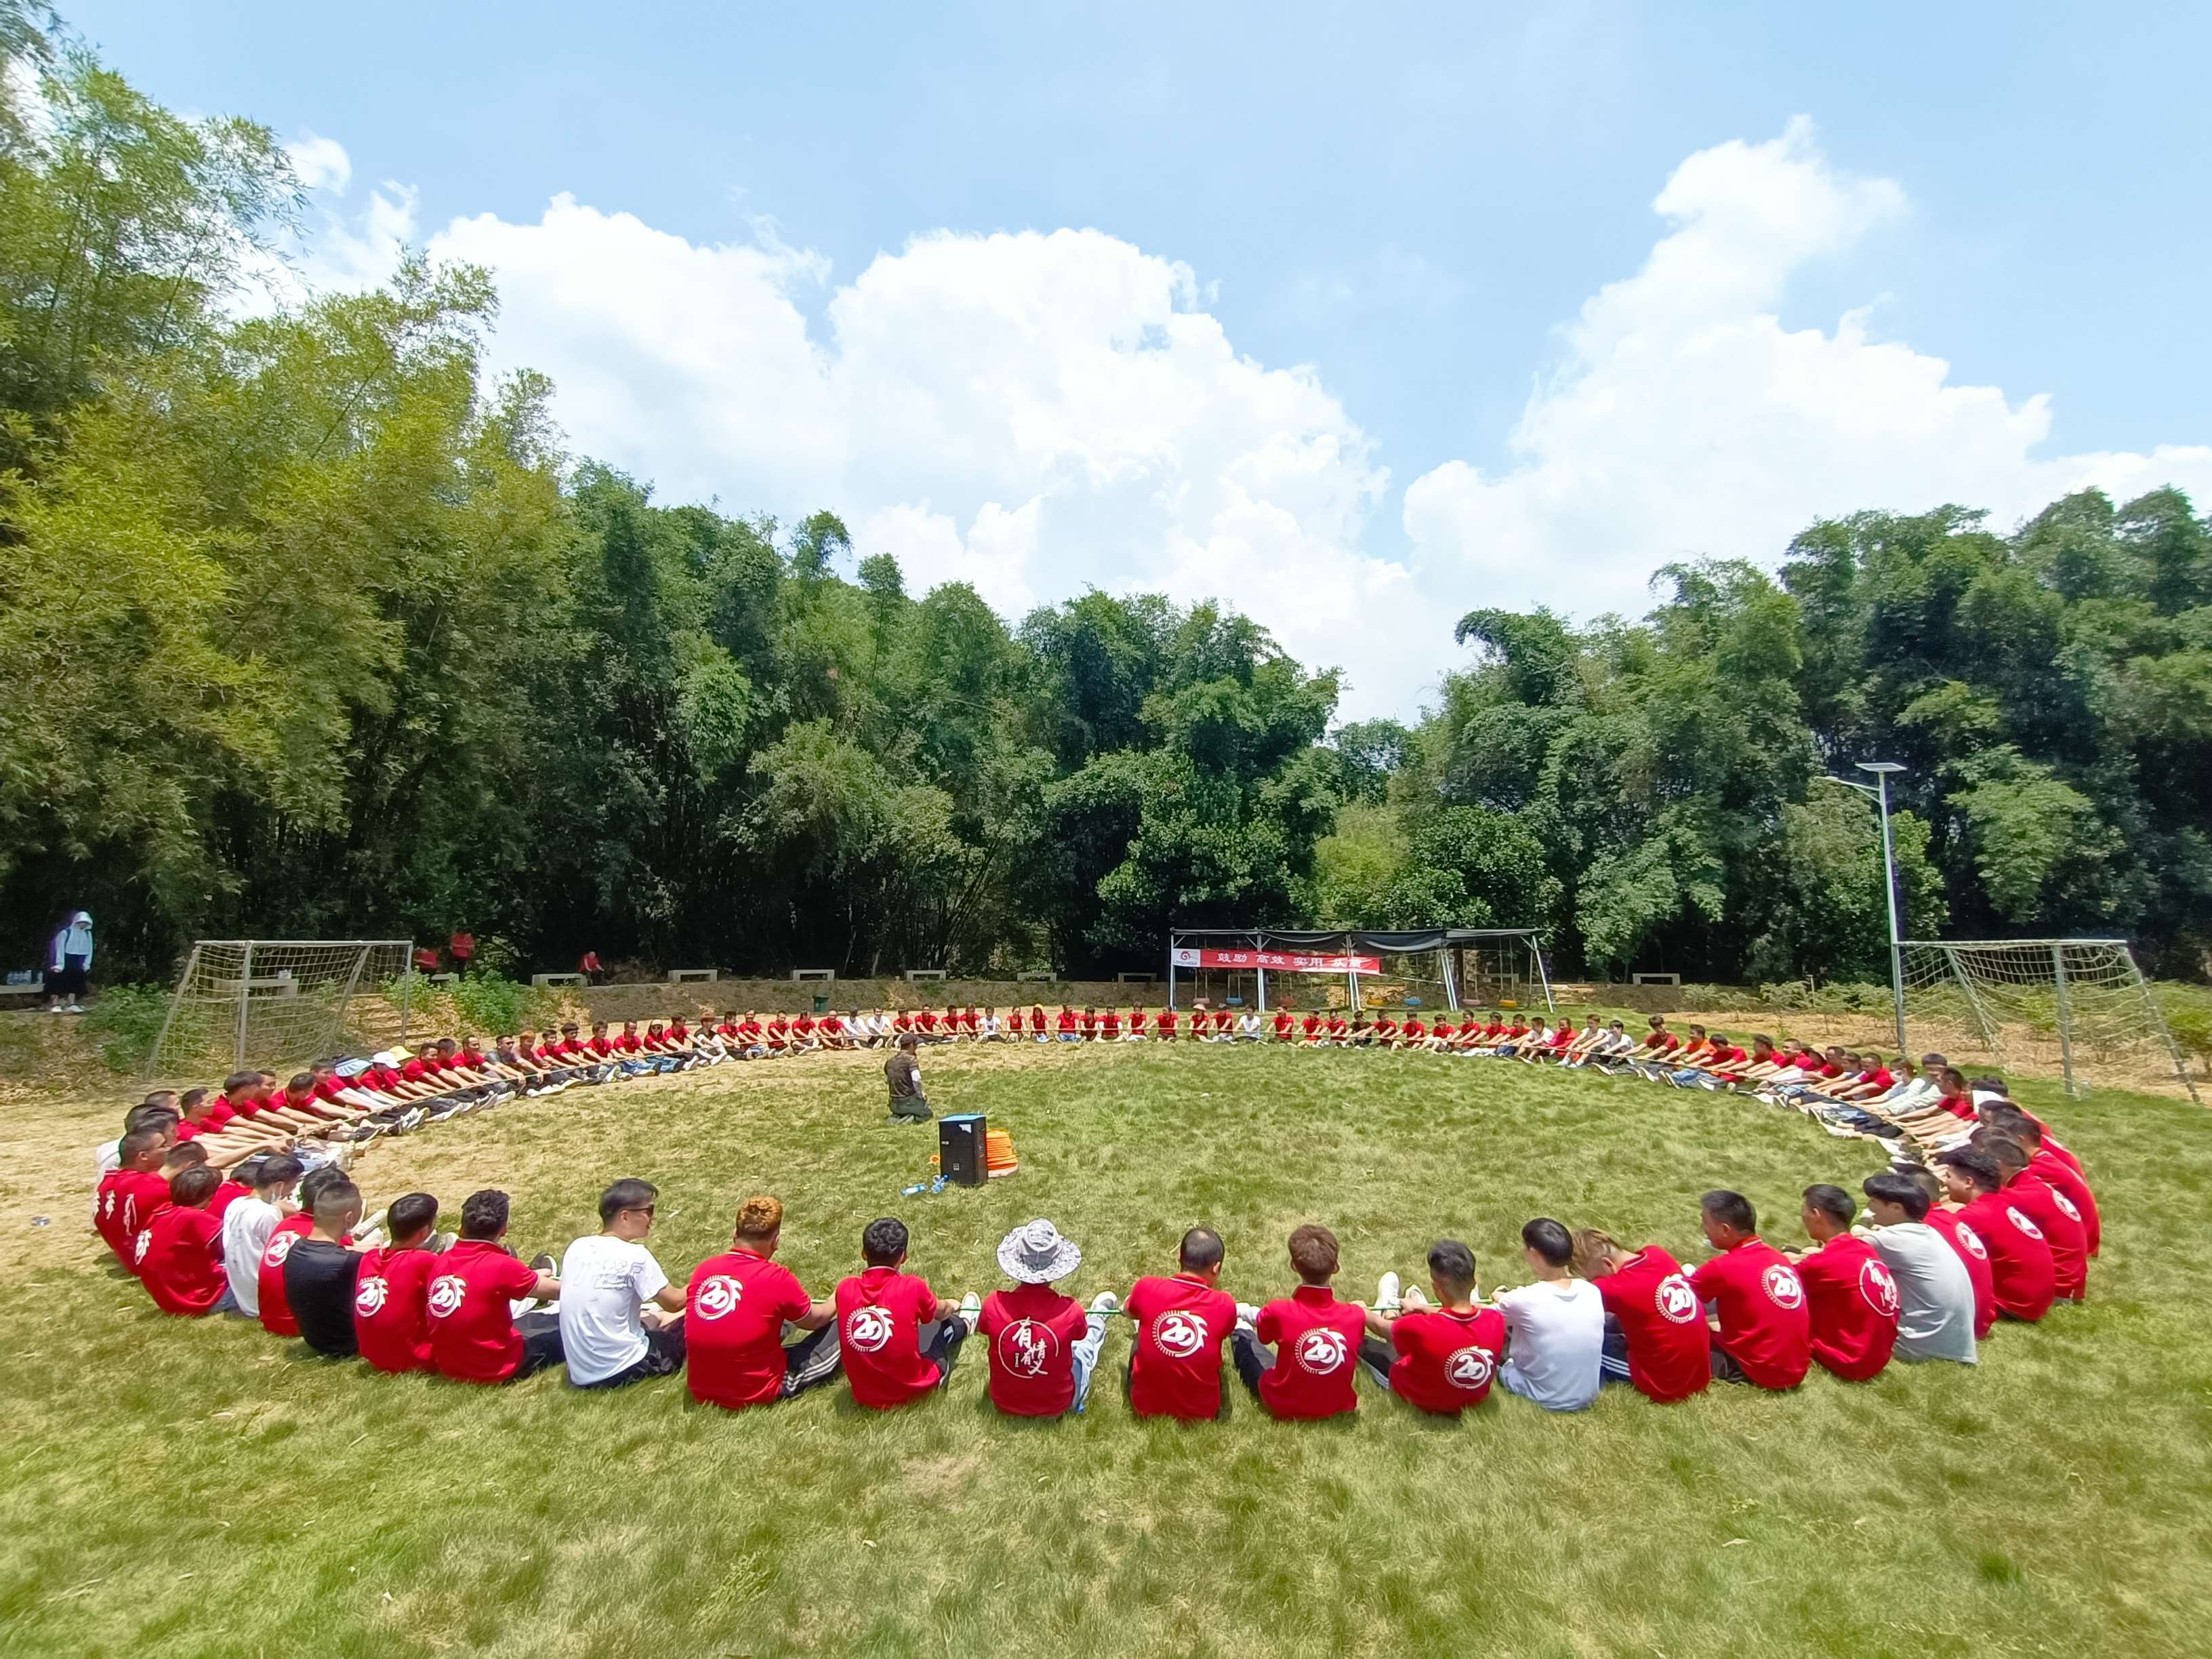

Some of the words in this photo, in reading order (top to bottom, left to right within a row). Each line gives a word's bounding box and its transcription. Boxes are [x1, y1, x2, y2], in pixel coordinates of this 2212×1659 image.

[1217, 953, 1247, 963] 鼓励
[1255, 954, 1285, 965] 高效
[1292, 957, 1323, 966] 实用
[700, 1280, 730, 1309] 20
[1663, 1286, 1692, 1313] 20
[853, 1313, 883, 1340] 20
[1160, 1317, 1195, 1347] 20
[1305, 1336, 1336, 1364] 20
[1454, 1355, 1486, 1380] 20
